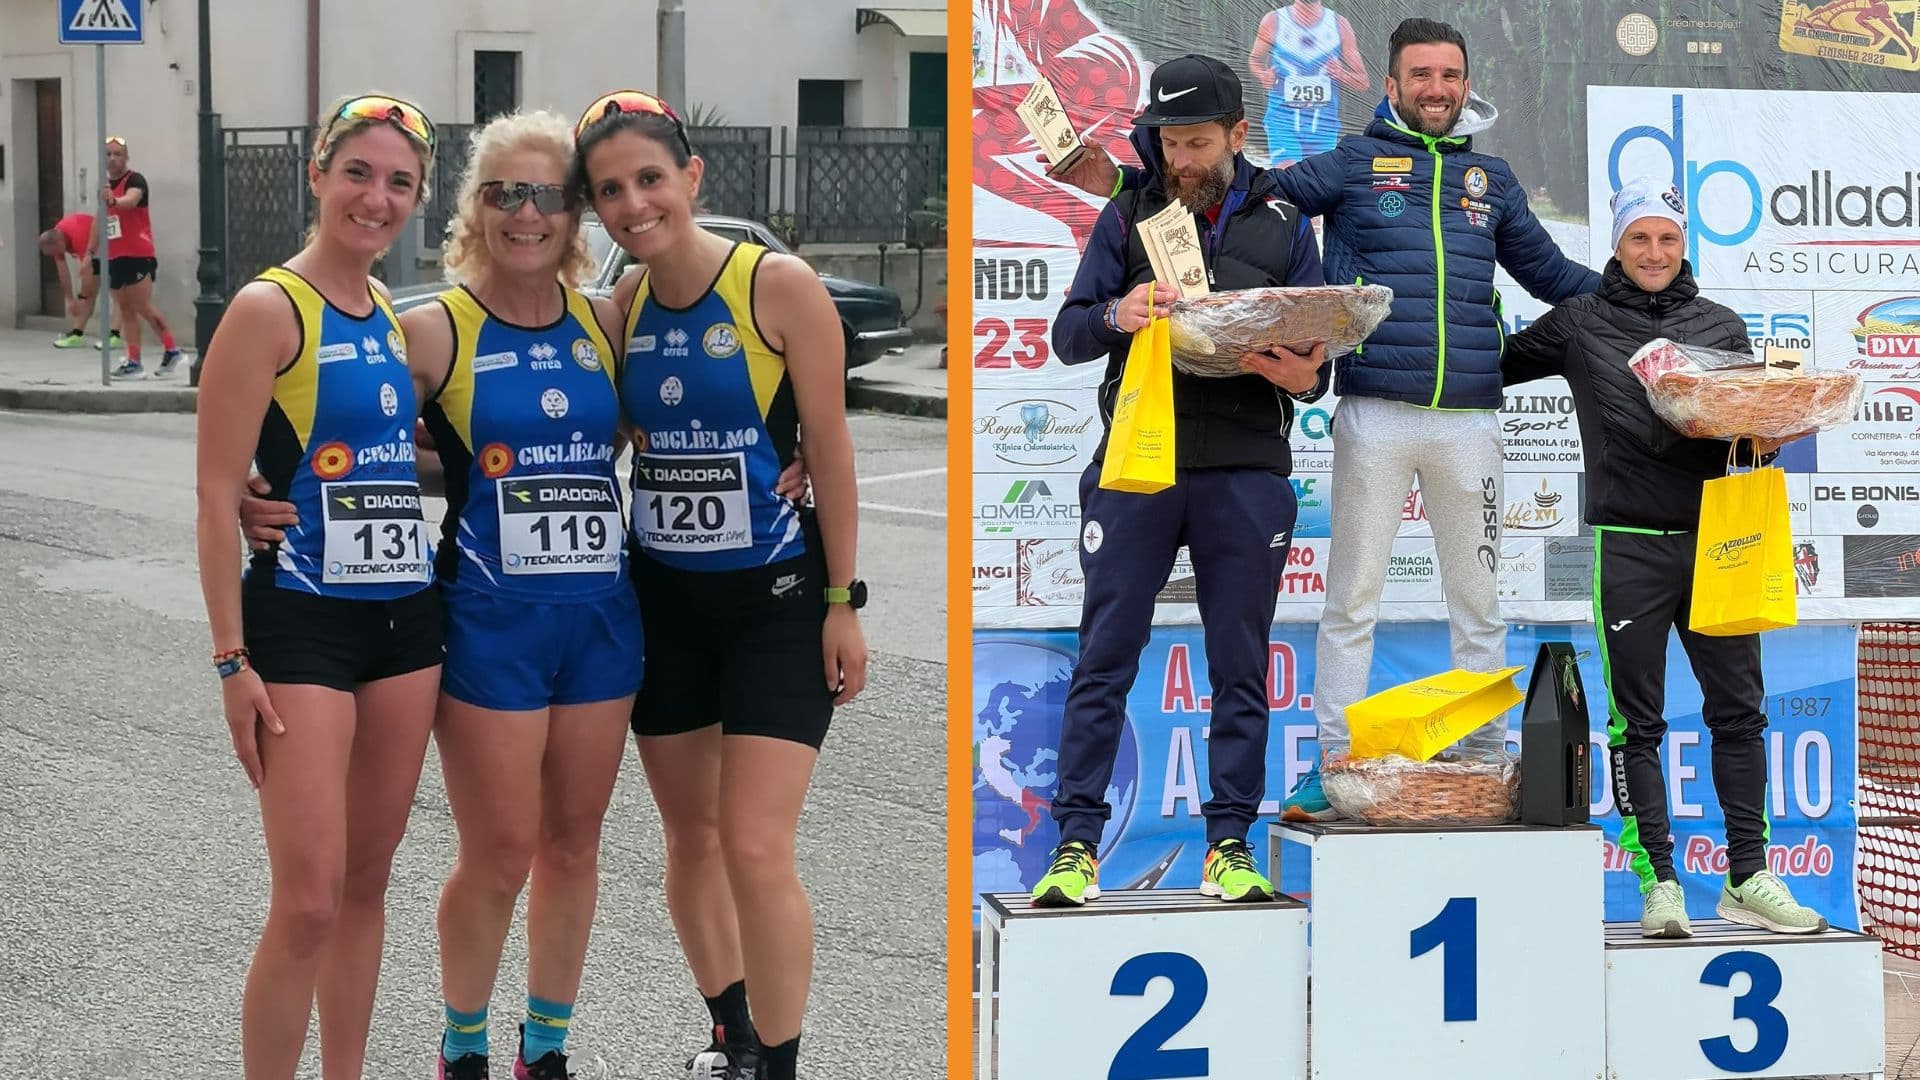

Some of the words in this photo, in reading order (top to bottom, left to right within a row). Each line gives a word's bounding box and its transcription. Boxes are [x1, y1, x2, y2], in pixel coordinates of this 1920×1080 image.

[1292, 85, 1324, 100] 259
[974, 258, 1048, 300] NDO
[974, 318, 1049, 369] 23
[1750, 338, 1811, 349] COLINO
[1871, 337, 1920, 355] DIV
[650, 419, 759, 449] GUGLIELMO
[1503, 416, 1568, 436] Sport
[1502, 438, 1558, 447] CERIGNOLA
[1560, 438, 1580, 448] (Fg)
[1851, 432, 1903, 441] CORNETTERIA
[1503, 452, 1580, 462] AZZOLLINO.COM
[1864, 450, 1876, 458] Via
[654, 468, 736, 482] DIADORA
[539, 488, 612, 502] DIADORA
[1814, 486, 1846, 501] DE
[1851, 486, 1920, 501] BONIS
[649, 495, 726, 530] 120
[1481, 476, 1497, 541] asics
[1534, 508, 1558, 521] XVI
[354, 522, 420, 561] 131
[529, 515, 606, 552] 119
[1390, 556, 1433, 566] RMACIA
[1388, 566, 1433, 576] CCIARDI
[1777, 697, 1832, 718] 1987
[1614, 751, 1633, 812] Joma
[1411, 898, 1478, 1022] 1
[1107, 951, 1210, 1080] 2
[1699, 950, 1789, 1073] 3
